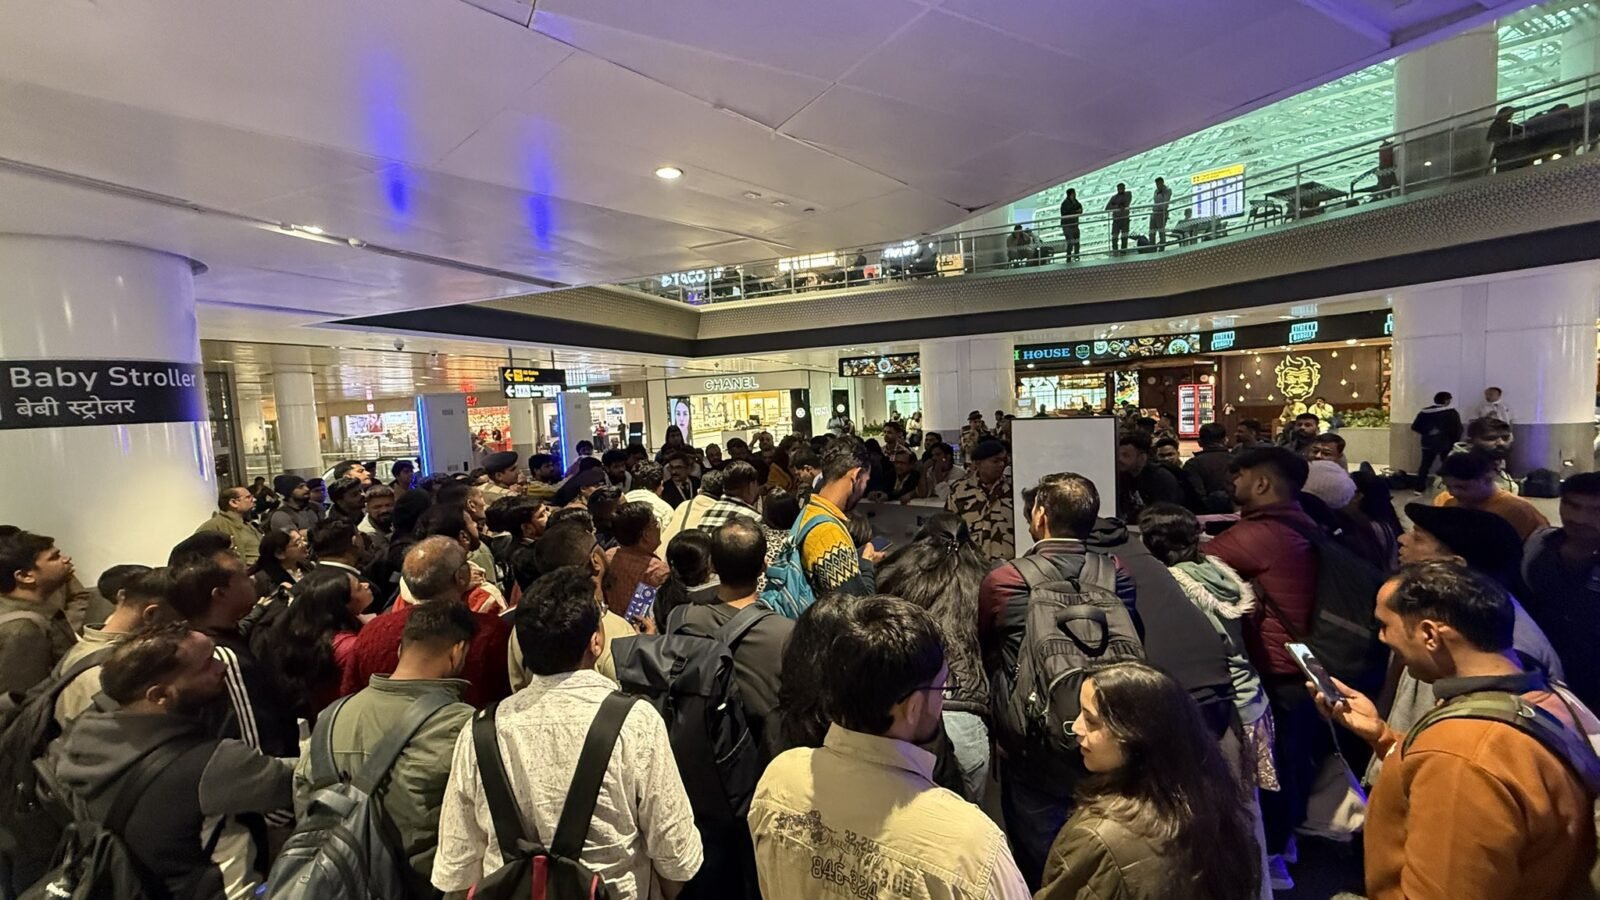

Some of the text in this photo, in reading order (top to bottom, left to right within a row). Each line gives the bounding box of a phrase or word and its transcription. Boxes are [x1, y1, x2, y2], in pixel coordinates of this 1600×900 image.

[671, 270, 706, 285] TACO
[1023, 348, 1070, 360] HOUSE
[9, 366, 197, 392] Baby Stroller
[704, 376, 760, 391] CHANEL
[15, 395, 136, 419] बेबी स्ट्रोलर
